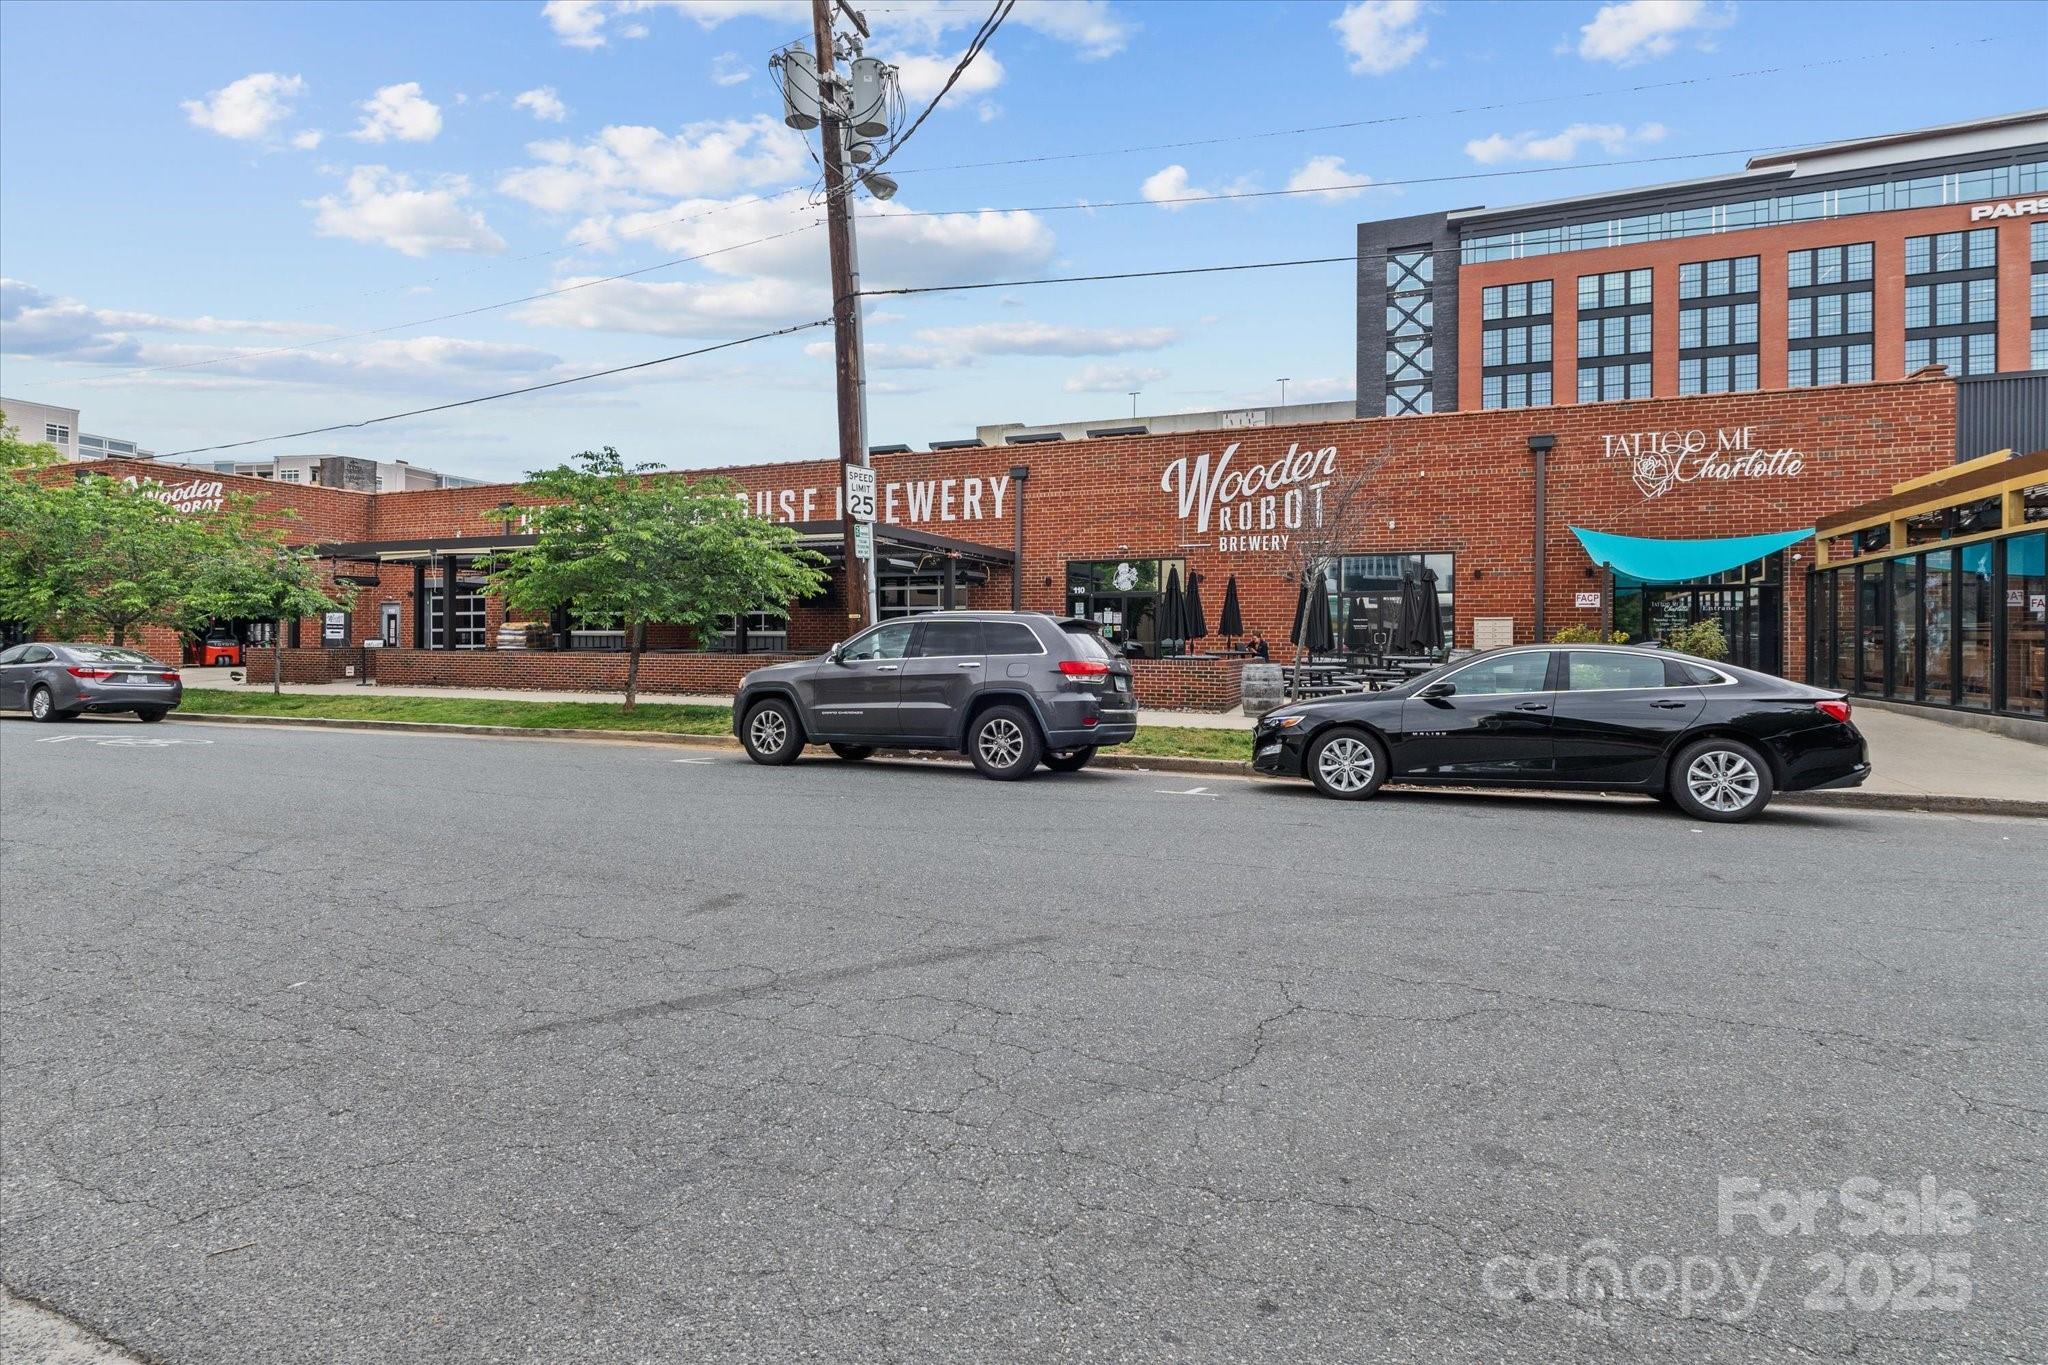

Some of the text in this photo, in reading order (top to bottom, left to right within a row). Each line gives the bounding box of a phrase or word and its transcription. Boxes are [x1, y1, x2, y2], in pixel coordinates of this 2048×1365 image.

[1602, 426, 1757, 457] TATTOO ME
[1674, 447, 1804, 481] Charlotte
[849, 472, 874, 482] SPEED
[851, 483, 871, 493] LIMIT
[1161, 442, 1337, 533] Wooden
[850, 495, 874, 516] 25
[1219, 481, 1331, 531] ROBOT
[1219, 535, 1289, 551] BREWERY
[1073, 586, 1086, 594] 110
[1576, 594, 1599, 602] FACP
